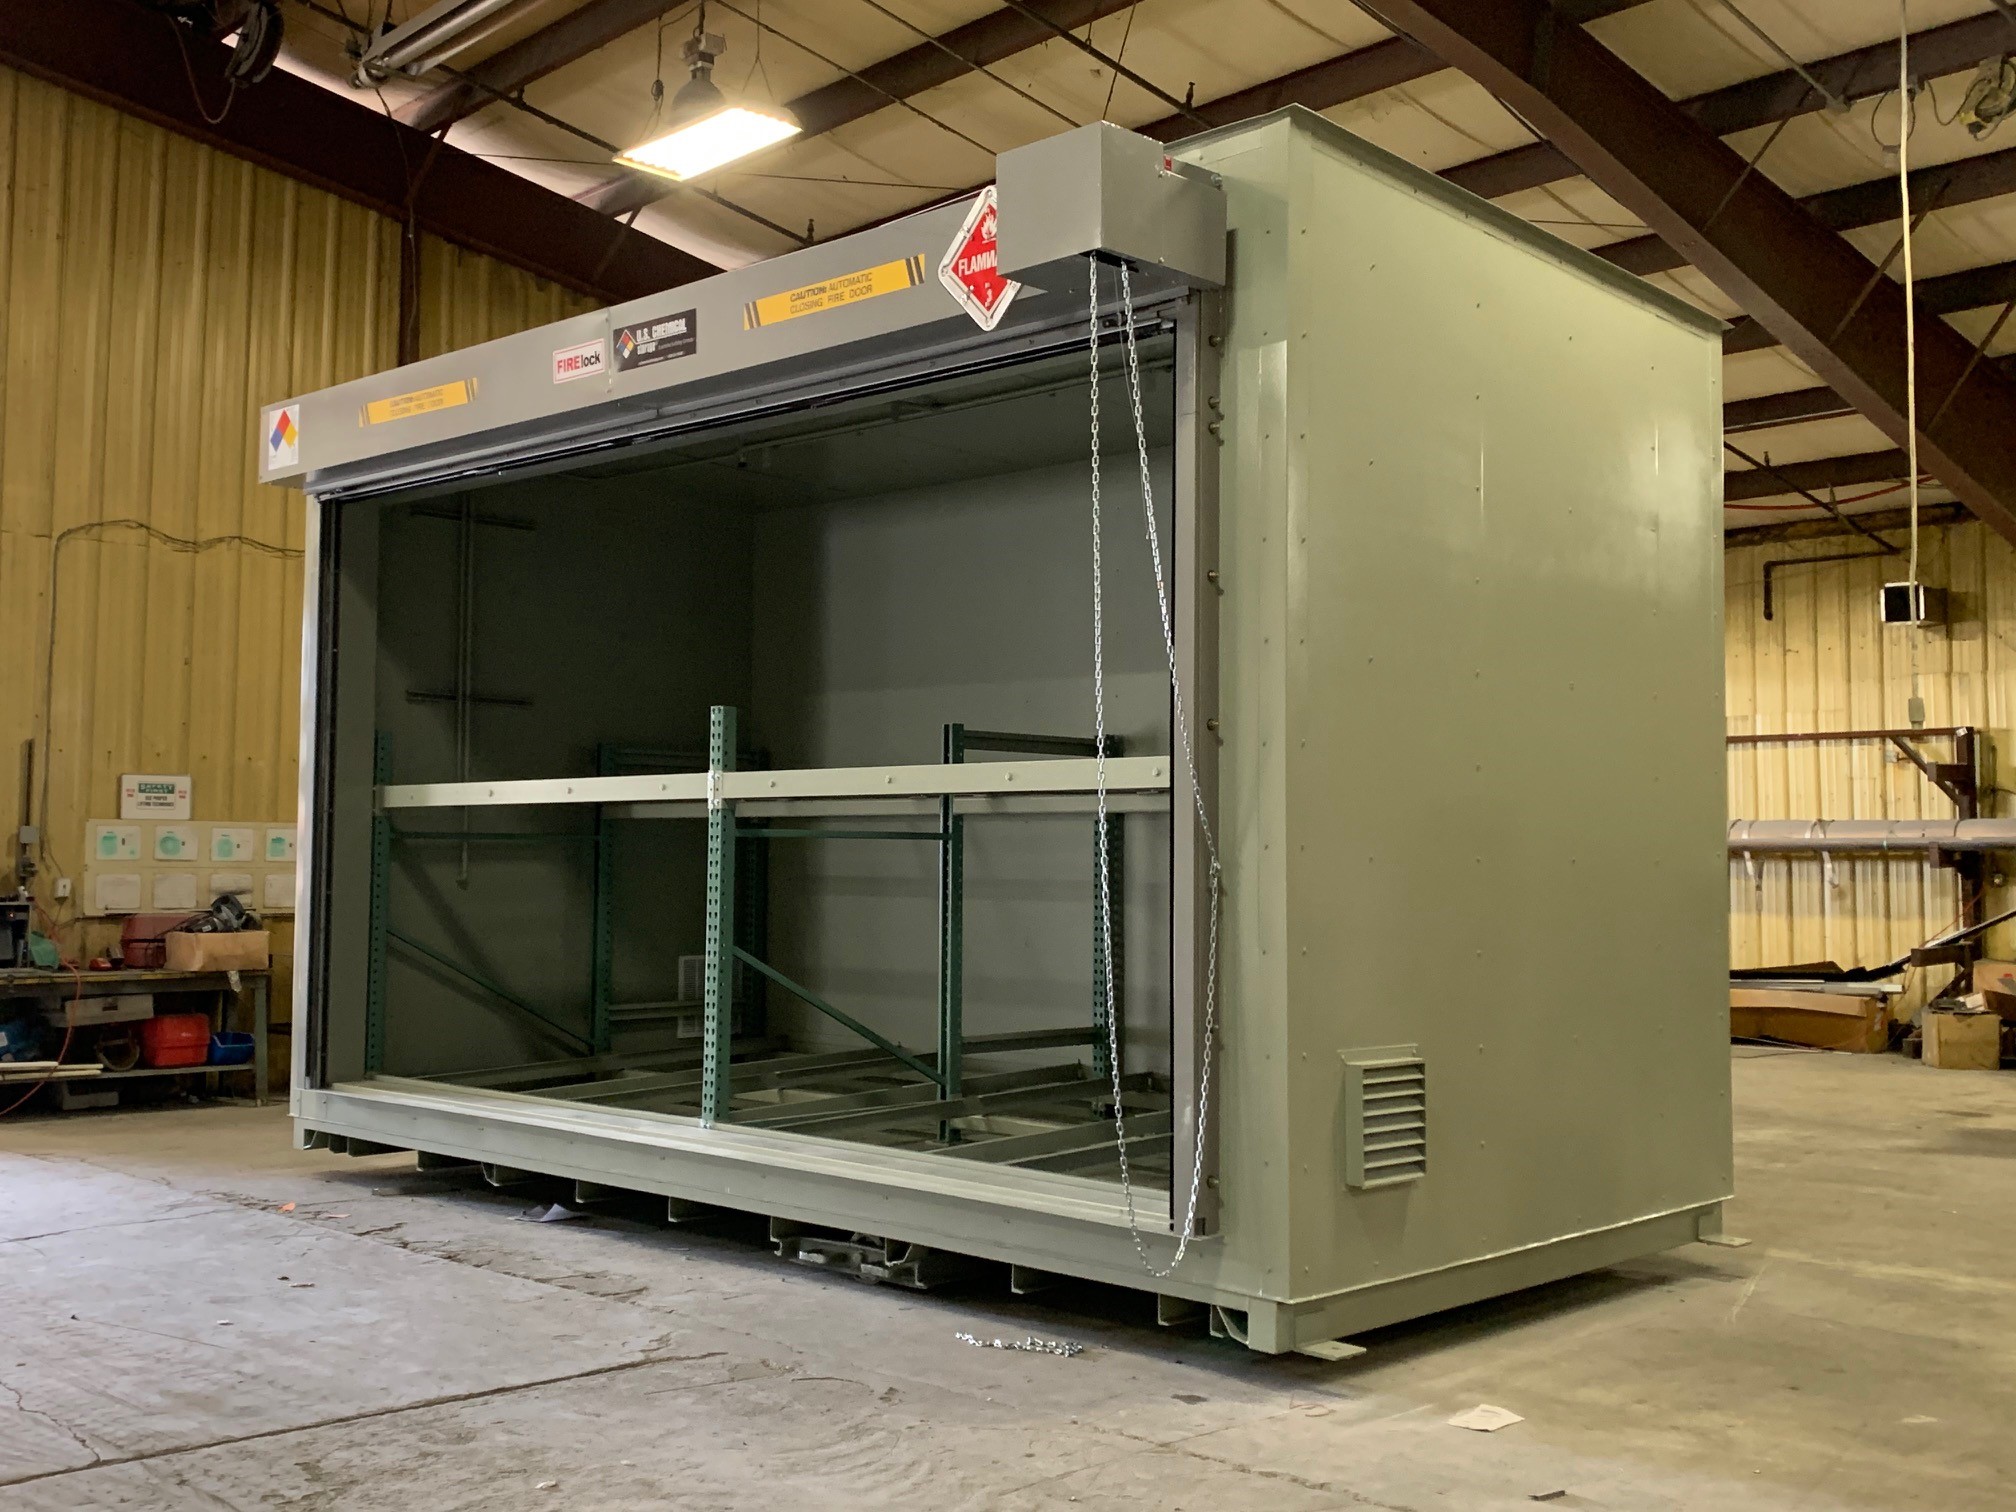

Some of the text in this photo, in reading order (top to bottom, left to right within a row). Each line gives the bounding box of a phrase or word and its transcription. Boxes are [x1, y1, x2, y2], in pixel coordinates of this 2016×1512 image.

[828, 272, 873, 291] AUTOMATIC
[789, 284, 873, 315] CLOSING FIRE DOOR
[557, 350, 601, 375] FIRElock
